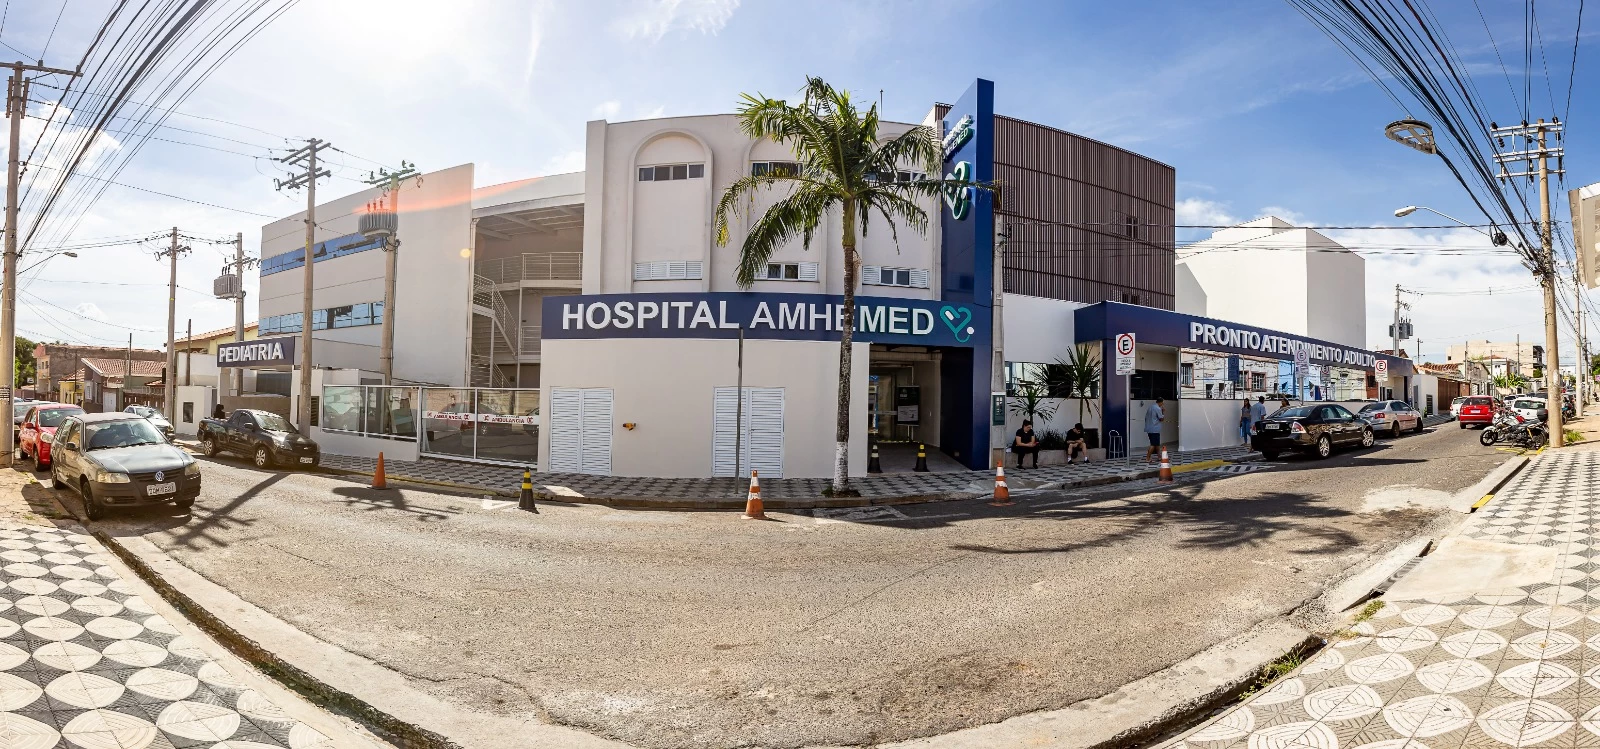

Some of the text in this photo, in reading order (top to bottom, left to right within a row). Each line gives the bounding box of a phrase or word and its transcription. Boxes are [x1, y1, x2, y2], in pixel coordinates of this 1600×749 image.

[562, 301, 934, 335] HOSPITAL AMHEMED
[219, 342, 284, 362] PEDIATRIA
[1122, 339, 1129, 351] E
[1190, 321, 1260, 350] PRONTO
[1342, 350, 1376, 368] ADULTO
[1379, 362, 1385, 370] E
